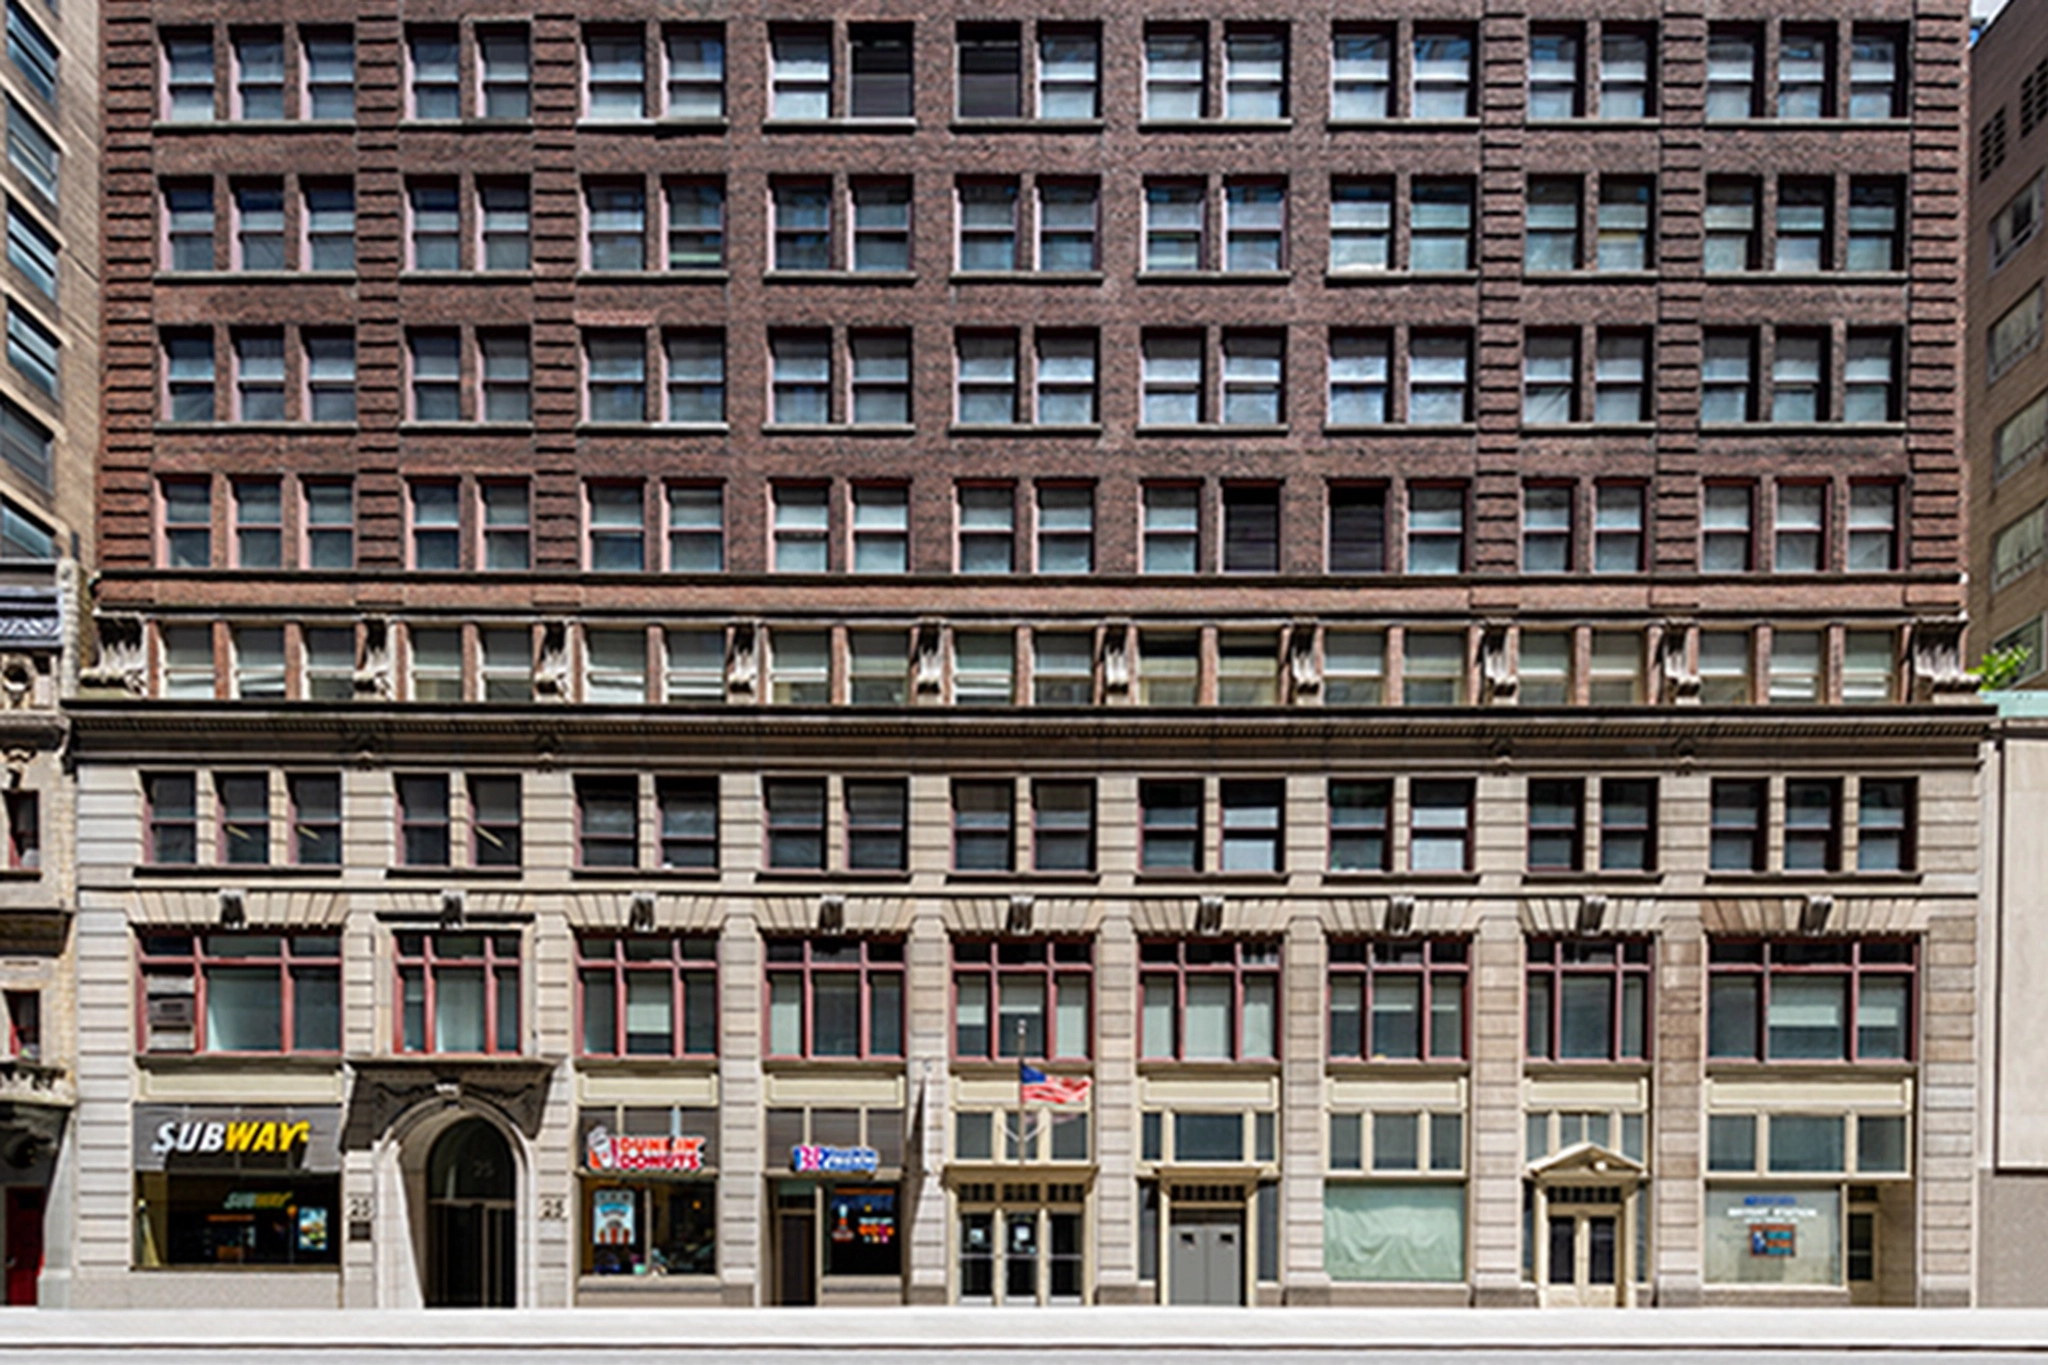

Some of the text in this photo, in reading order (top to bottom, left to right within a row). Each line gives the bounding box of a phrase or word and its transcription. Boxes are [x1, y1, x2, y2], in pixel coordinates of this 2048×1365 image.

[152, 1121, 311, 1152] SUBWAY
[619, 1153, 699, 1170] DONUTS
[542, 1199, 565, 1219] 25
